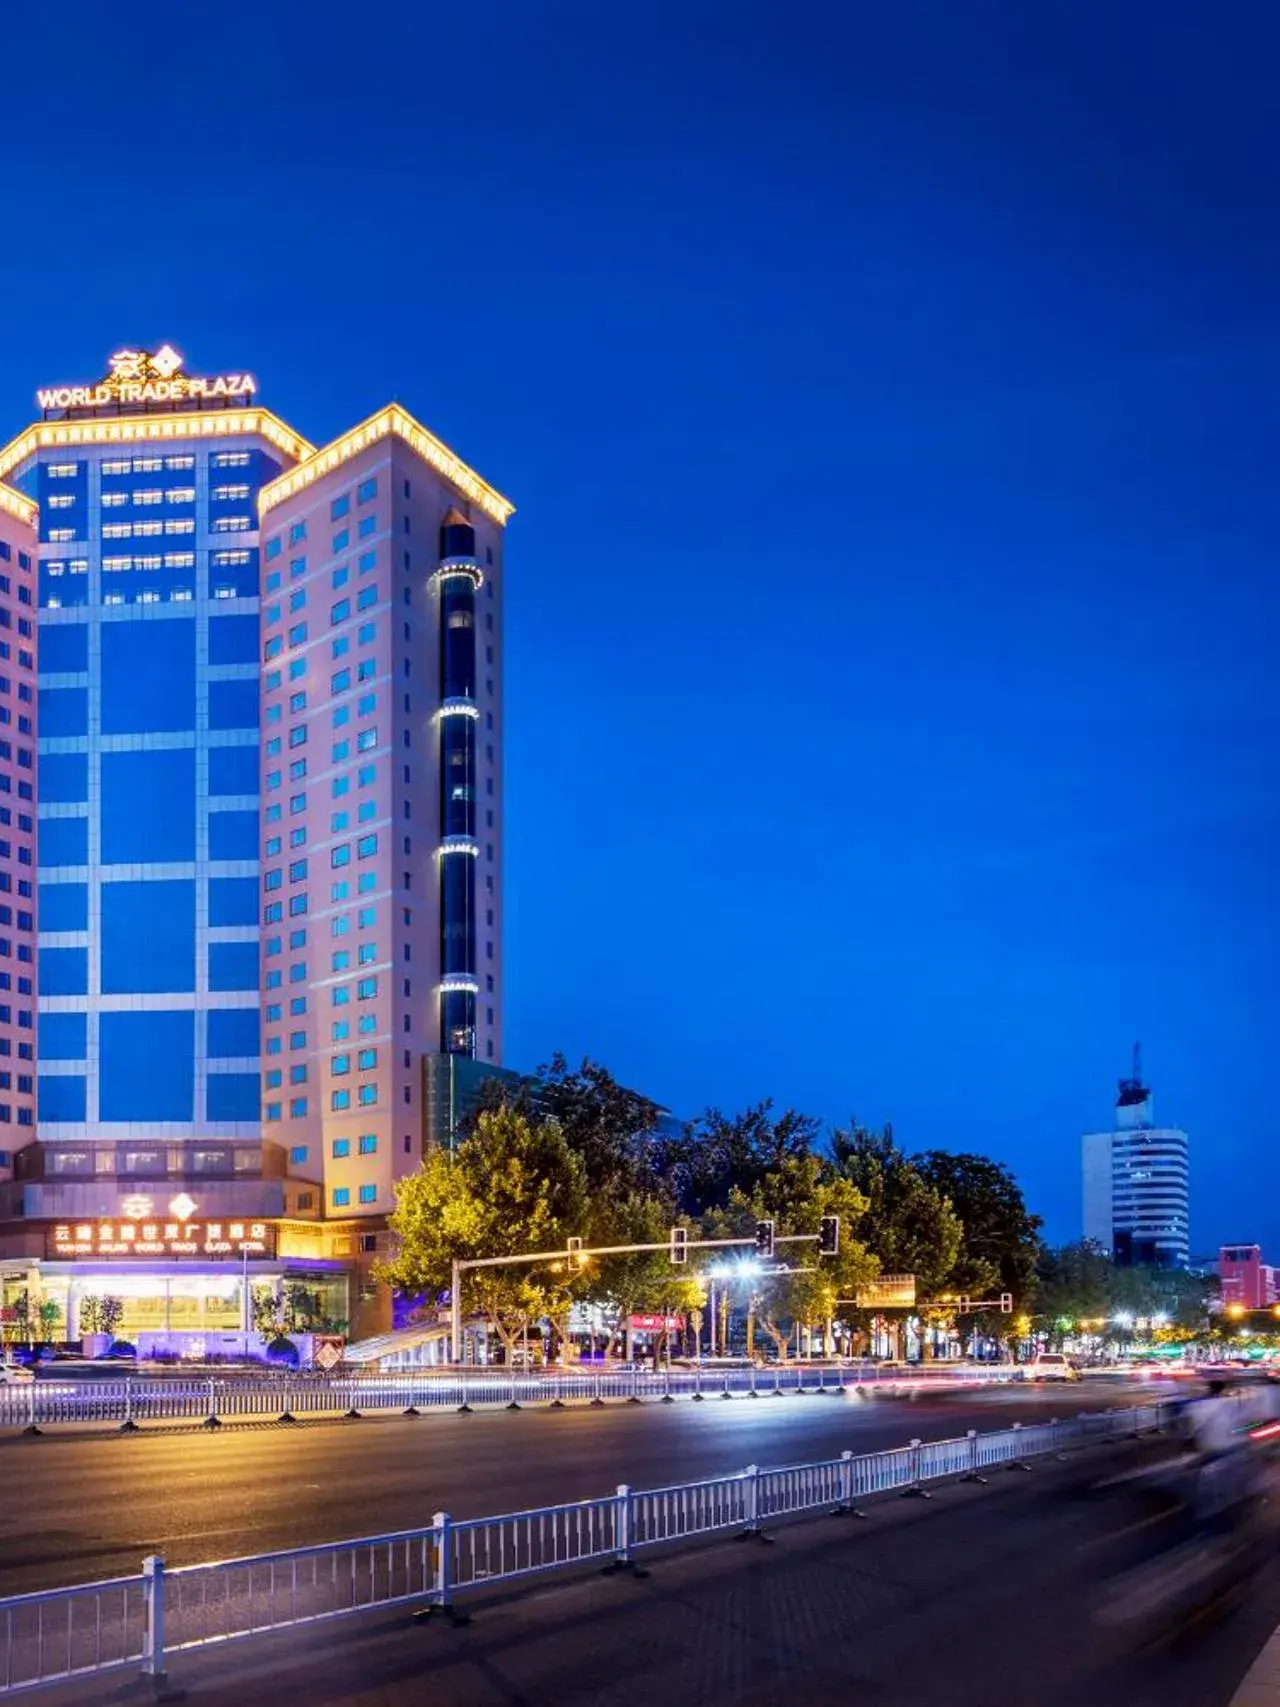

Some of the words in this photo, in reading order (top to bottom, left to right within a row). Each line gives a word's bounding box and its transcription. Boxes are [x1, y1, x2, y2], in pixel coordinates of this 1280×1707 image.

[37, 387, 111, 408] WORLD
[118, 382, 183, 403] TRADE
[189, 375, 256, 397] PLAZA
